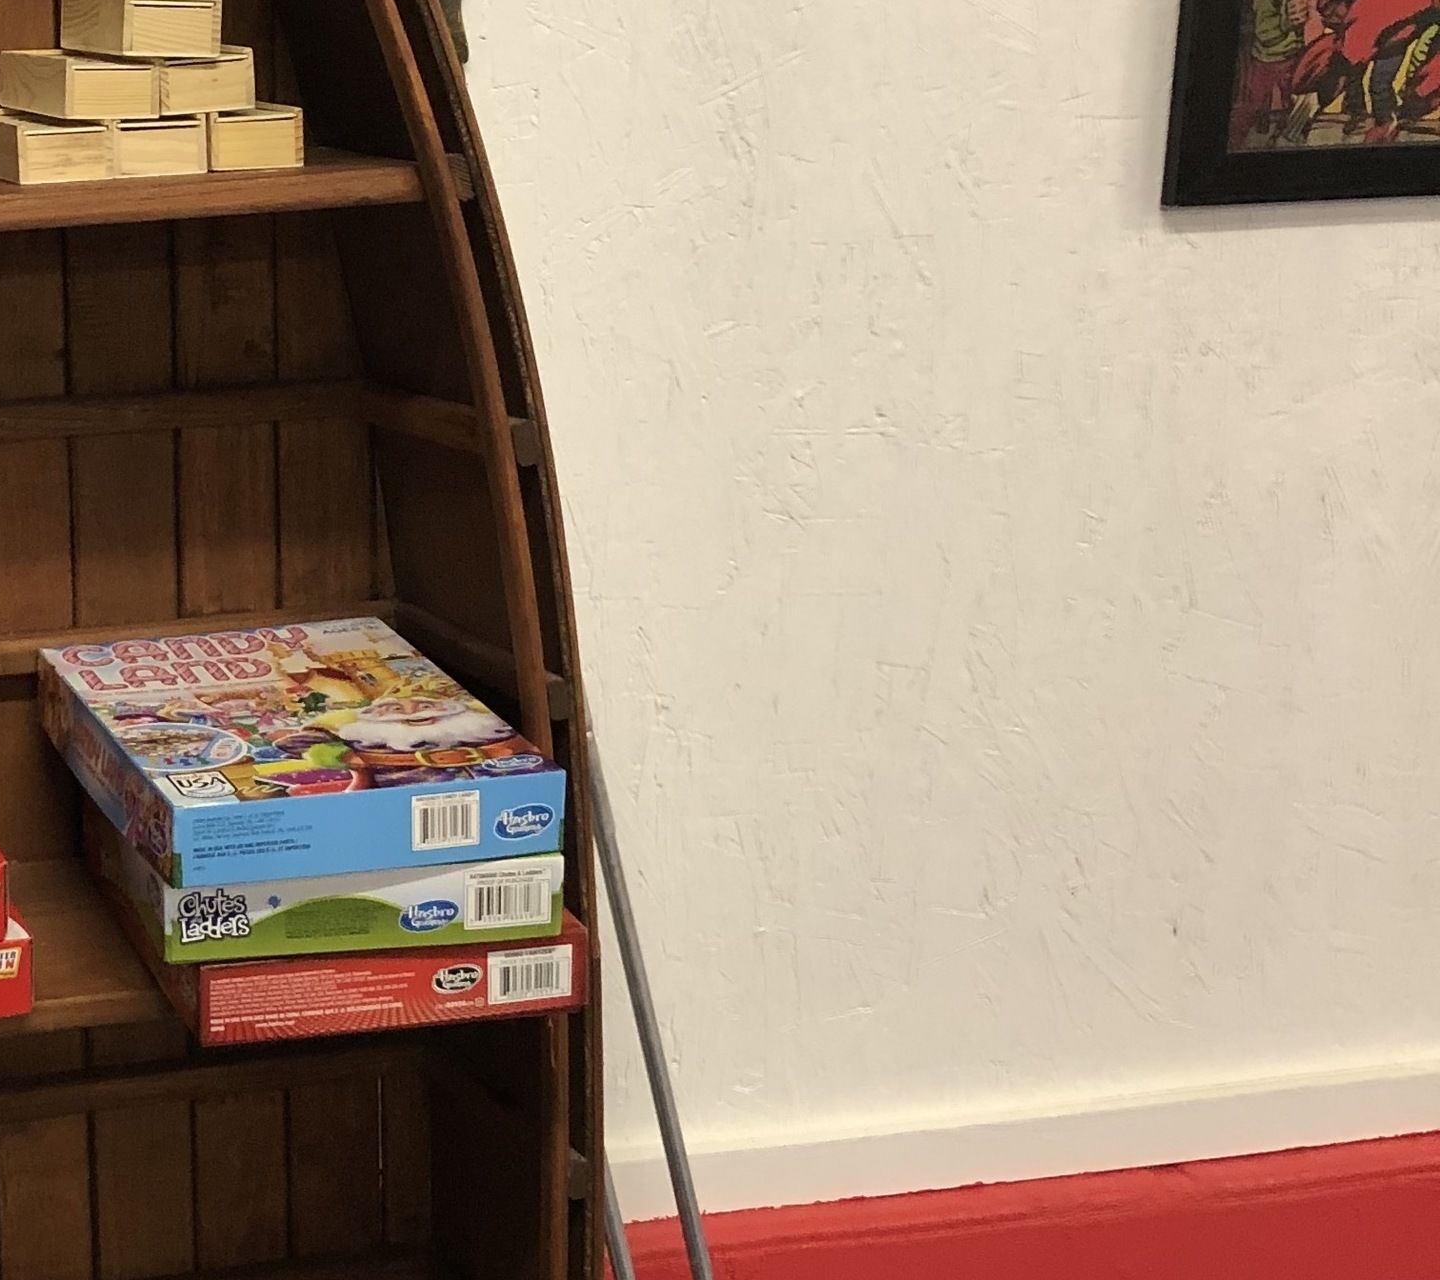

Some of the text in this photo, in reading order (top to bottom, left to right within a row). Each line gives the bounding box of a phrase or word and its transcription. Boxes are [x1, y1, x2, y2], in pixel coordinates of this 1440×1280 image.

[62, 624, 309, 668] CANDY
[79, 657, 273, 692] LAND
[176, 776, 227, 789] USA
[500, 809, 550, 826] Hasbro
[179, 889, 247, 918] Chutes
[408, 906, 456, 920] Hasbro
[179, 913, 251, 944] Ladders
[439, 968, 479, 982] Hasbro
